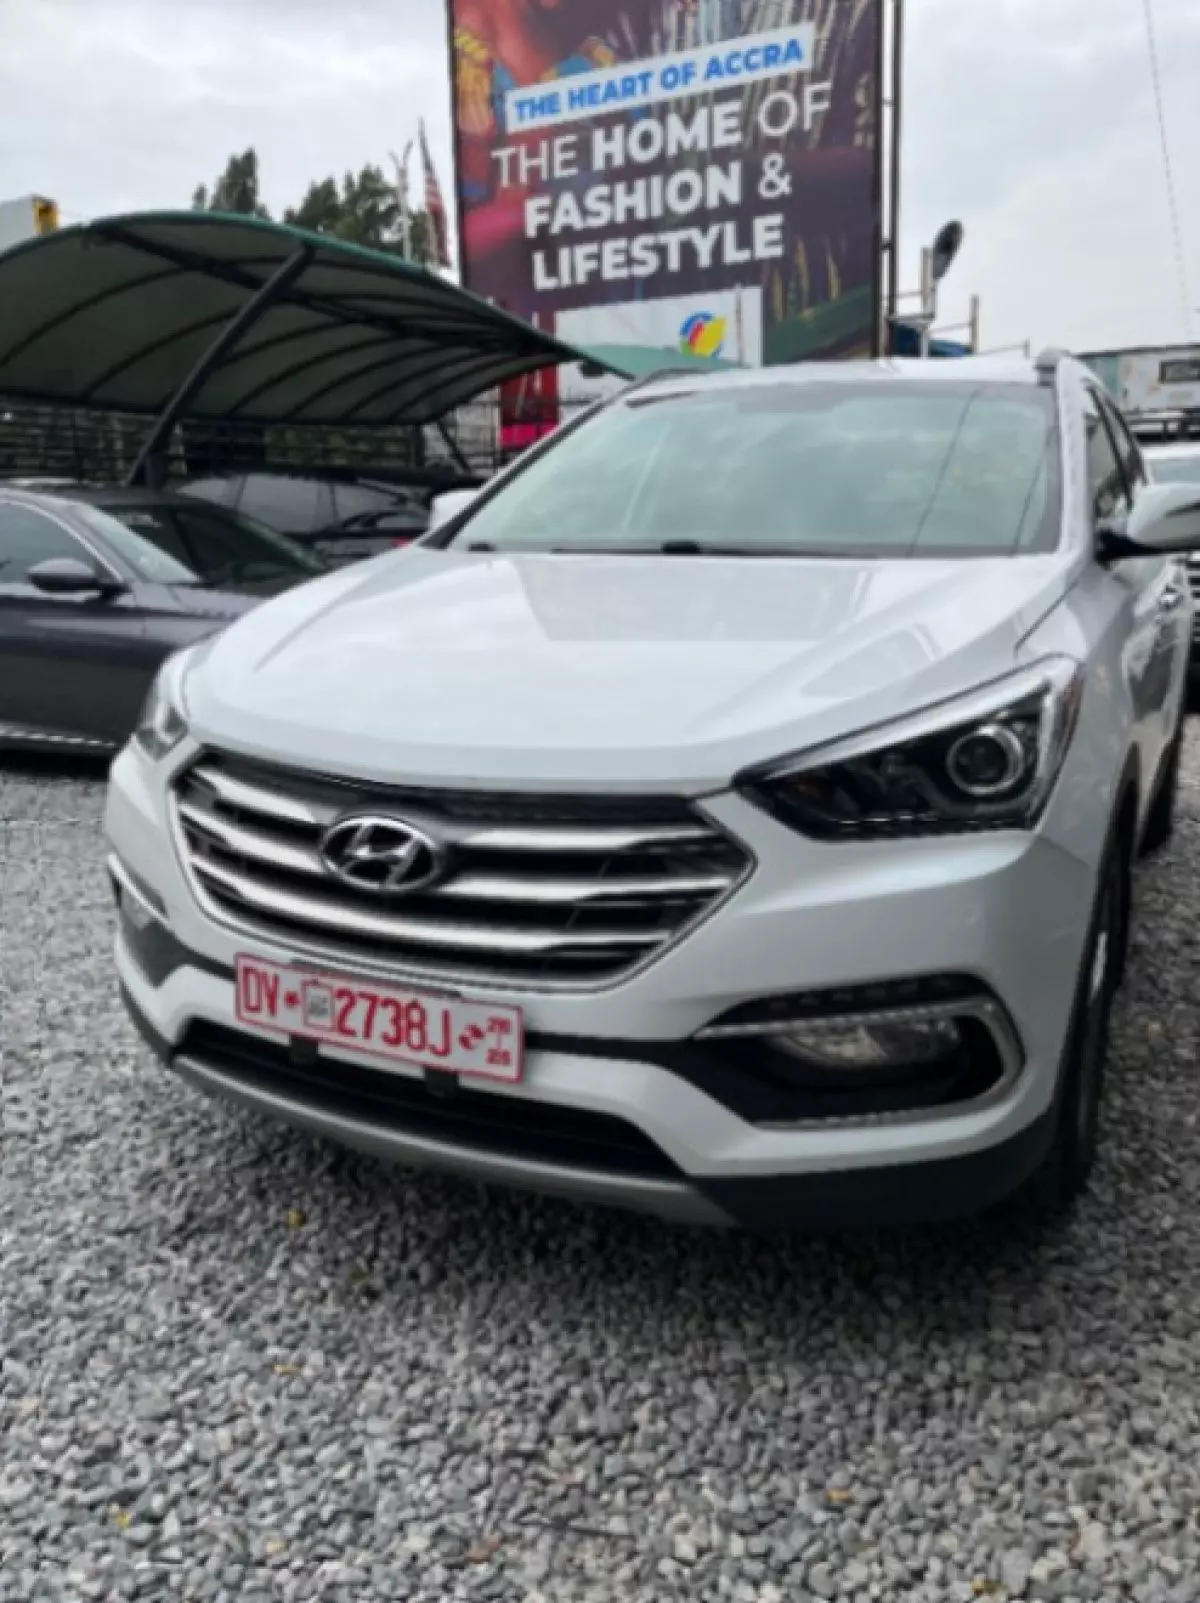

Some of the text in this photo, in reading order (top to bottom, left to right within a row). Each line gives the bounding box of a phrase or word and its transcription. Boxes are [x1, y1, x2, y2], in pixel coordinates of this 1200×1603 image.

[514, 39, 803, 121] THE HEART OF ACCRA
[491, 81, 832, 188] THE HOME OF
[525, 152, 792, 239] FASHION &
[532, 214, 784, 291] LIFESTYLE
